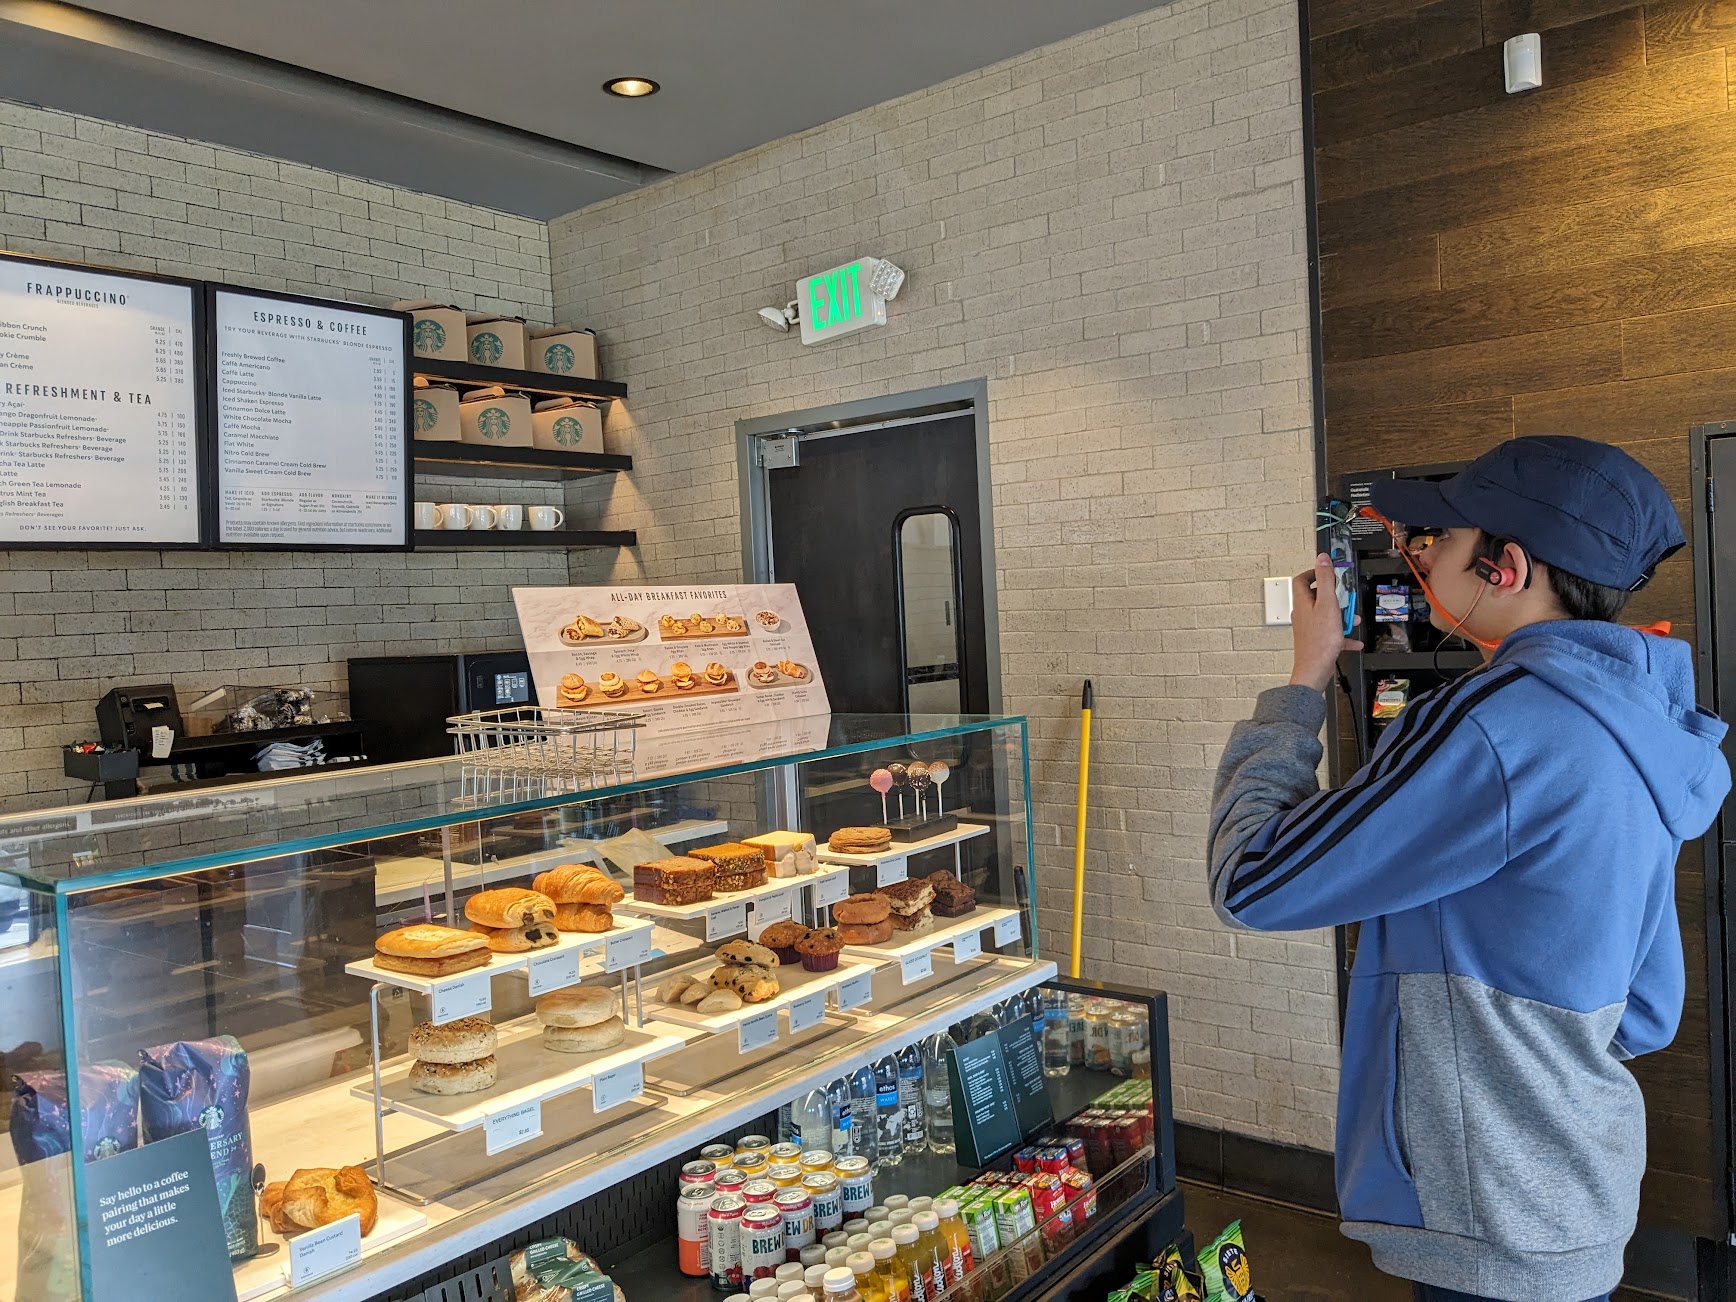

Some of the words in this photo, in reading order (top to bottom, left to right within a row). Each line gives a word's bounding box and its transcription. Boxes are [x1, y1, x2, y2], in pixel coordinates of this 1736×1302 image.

[27, 282, 126, 305] FRAPPUCCINO
[808, 262, 861, 331] EXIT
[76, 301, 99, 309] BEVERAGES
[22, 324, 47, 332] Crunch
[253, 311, 311, 329] ESPRESSO
[317, 320, 324, 330] &
[329, 321, 367, 336] COFFEE
[16, 333, 46, 341] Crumble
[238, 327, 255, 335] YOUR
[257, 329, 288, 339] BEVERAGE
[343, 340, 364, 348] BLONDE
[365, 343, 392, 352] ESPRESSO
[5, 352, 29, 360] Crème
[221, 351, 242, 360] Freshly
[243, 353, 265, 361] Brewed
[266, 355, 285, 363] Coffee
[10, 362, 33, 370] Crème
[238, 361, 270, 371] Americano
[239, 370, 254, 378] Latte
[222, 378, 257, 387] Cappuccino
[6, 382, 105, 401] REFRESHMENT
[113, 391, 121, 402] &
[129, 392, 151, 405] TEA
[289, 392, 307, 400] Vanilla
[259, 399, 284, 407] Espresso
[18, 412, 58, 420] Dragonfruit
[242, 415, 271, 423] Chocolate
[29, 422, 70, 431] Passionfruit
[20, 431, 54, 439] Starbucks
[96, 436, 126, 444] Beverage
[224, 431, 249, 439] Caramel
[250, 433, 279, 441] Macchiato
[6, 440, 40, 449] Starbucks
[82, 445, 112, 453] Beverage
[19, 451, 53, 459] Starbucks
[95, 455, 125, 463] Beverage
[611, 592, 643, 602] ALL-DAY
[645, 591, 688, 601] BREAKFAST
[690, 590, 727, 600] FAVORITES
[533, 958, 549, 967] Chocolate
[550, 954, 565, 962] Croissant
[879, 1084, 895, 1092] ethos
[492, 1112, 520, 1125] EVERYTHING
[520, 1107, 535, 1116] BAGEL
[99, 1194, 116, 1207] Say
[118, 1186, 142, 1201] hello
[142, 1183, 153, 1192] to
[153, 1181, 160, 1189] a
[160, 1170, 189, 1186] coffee
[843, 1182, 870, 1201] BREW
[101, 1201, 138, 1222] pairing
[138, 1194, 159, 1208] that
[159, 1183, 190, 1201] makes
[814, 1198, 838, 1218] BREW
[104, 1219, 127, 1236] your
[128, 1211, 146, 1225] day
[147, 1211, 154, 1219] a
[154, 1202, 177, 1216] little
[106, 1231, 133, 1247] more
[133, 1216, 178, 1237] delicious.
[298, 1243, 314, 1252] Vanilla
[314, 1238, 326, 1246] Bean
[326, 1231, 344, 1241] Custard
[752, 1233, 780, 1255] BREW
[299, 1249, 315, 1258] Danish
[1222, 1248, 1239, 1264] SIETE
[1163, 1262, 1178, 1277] SIET
